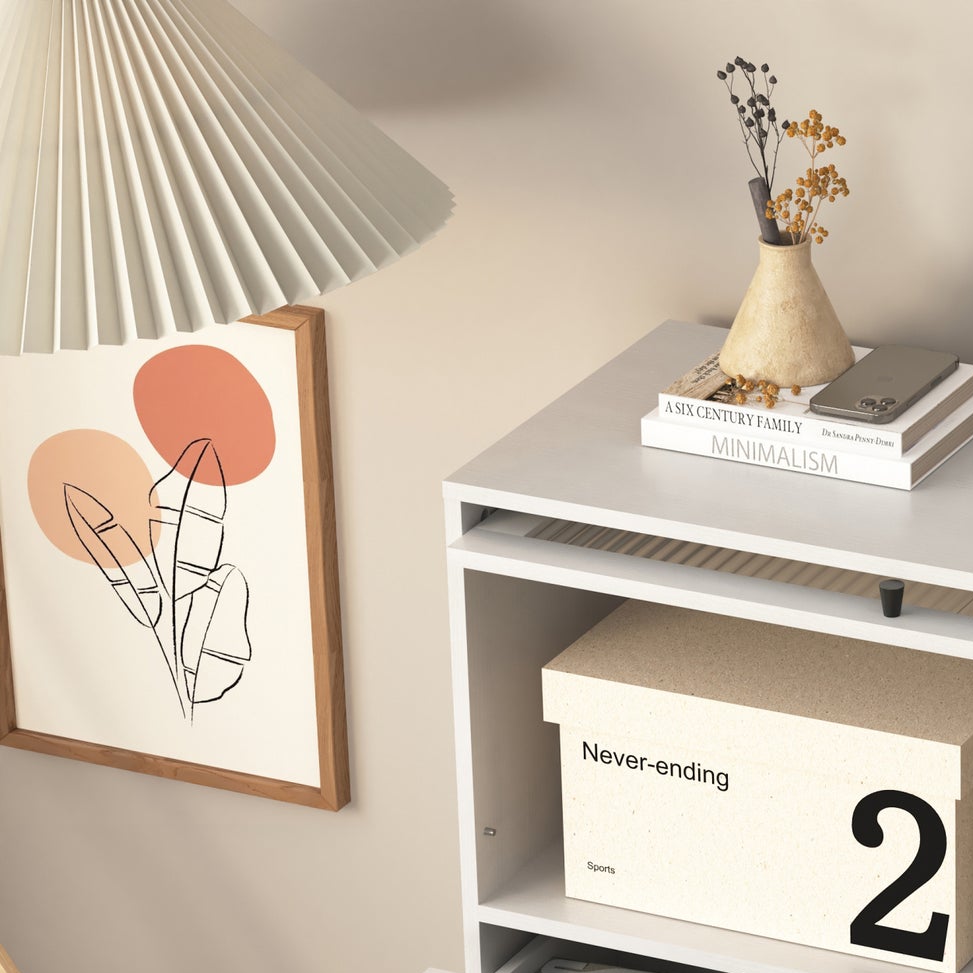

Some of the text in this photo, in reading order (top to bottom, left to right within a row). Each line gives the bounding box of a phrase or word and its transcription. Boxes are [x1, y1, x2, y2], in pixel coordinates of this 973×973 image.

[664, 401, 803, 435] A SIX CENTURY FAMILY
[711, 434, 838, 475] MINIMALISM
[581, 740, 730, 792] Never-ending
[586, 861, 616, 875] Sports
[849, 789, 950, 963] 2
